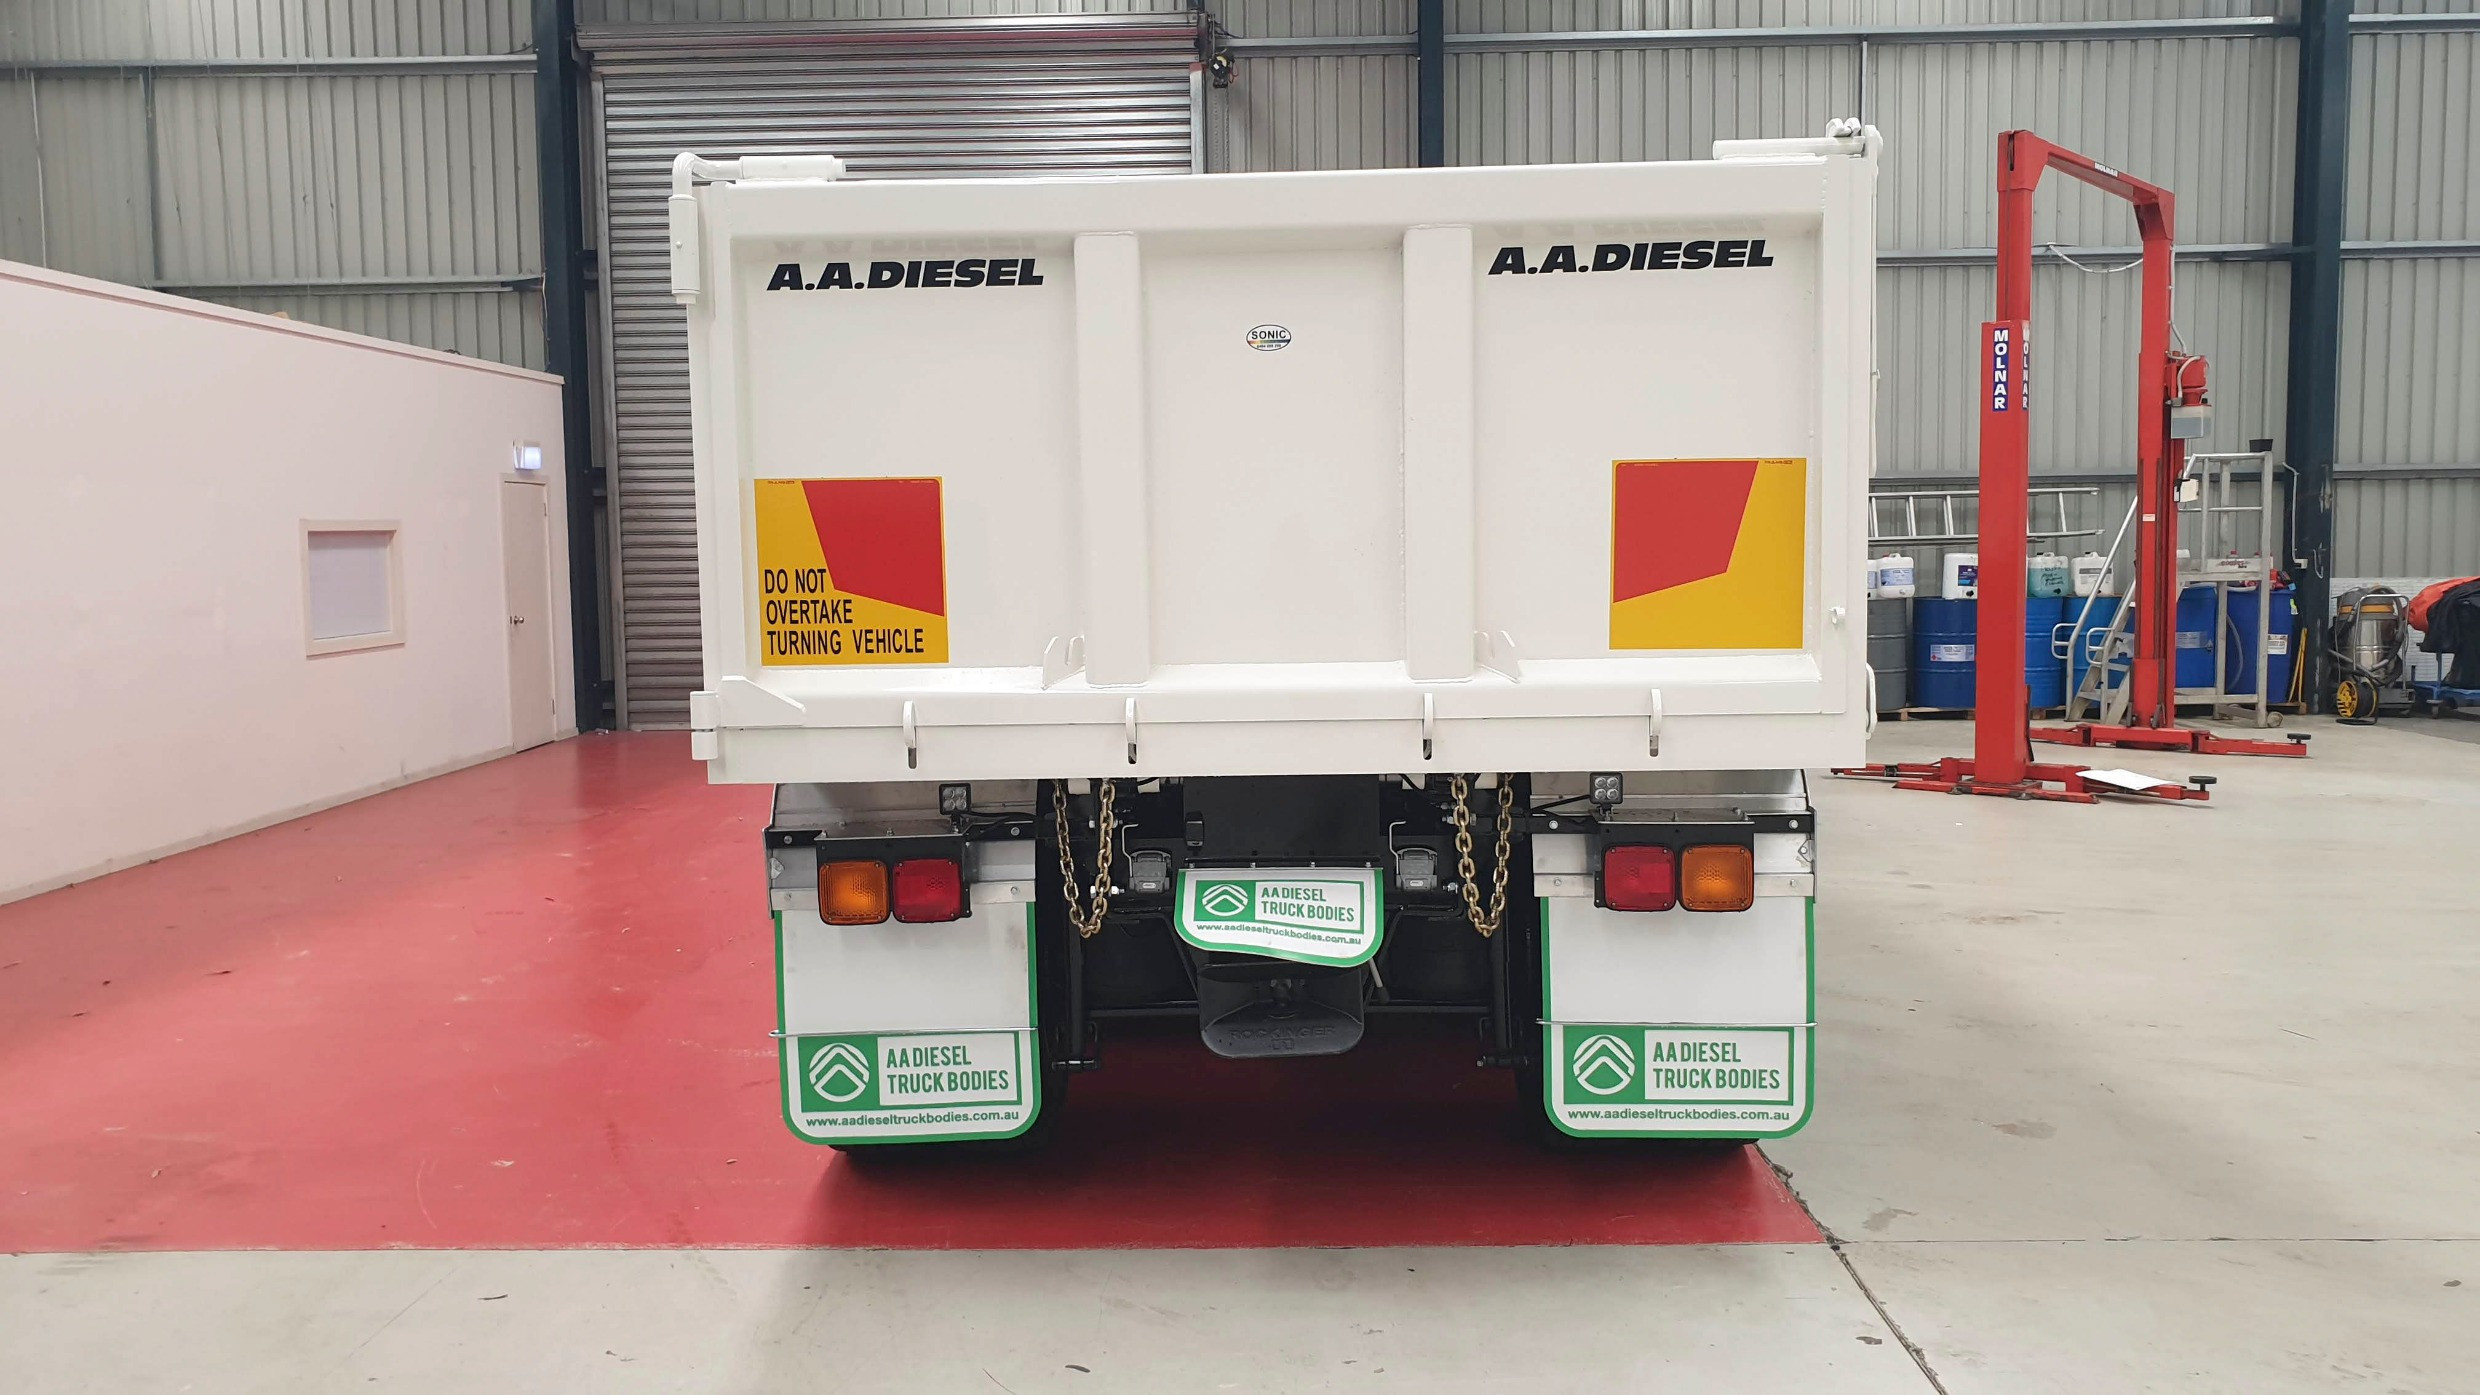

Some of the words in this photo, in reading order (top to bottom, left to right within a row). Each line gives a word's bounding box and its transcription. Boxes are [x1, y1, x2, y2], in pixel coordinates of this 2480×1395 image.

[1488, 239, 1774, 275] A.A.DIESEL
[766, 259, 1044, 291] A.A.DIESEL
[1251, 330, 1287, 340] SONIC
[1994, 329, 2009, 409] MOLNAR
[764, 568, 788, 594] DO
[795, 568, 826, 594] NOT
[766, 599, 853, 625] OVERTAKE
[767, 630, 841, 655] TURNING
[852, 629, 924, 654] VEHICLE
[1282, 888, 1327, 902] DIESEL
[1261, 901, 1305, 918] TRUCK
[1307, 903, 1355, 922] BODIES
[1197, 924, 1361, 945] www.aadieseltruckbodies.com.au
[913, 1045, 972, 1067] DIESEL
[1681, 1042, 1742, 1062] DIESEL
[887, 1072, 945, 1094] TRUCK
[947, 1070, 1009, 1092] BODIES
[1652, 1068, 1711, 1089] TRUCK
[1716, 1069, 1780, 1089] BODIES
[806, 1110, 1019, 1127] www.aadieseltruckbodies.com.au
[1568, 1108, 1790, 1121] www.aadieseltruckbodies.com.au
